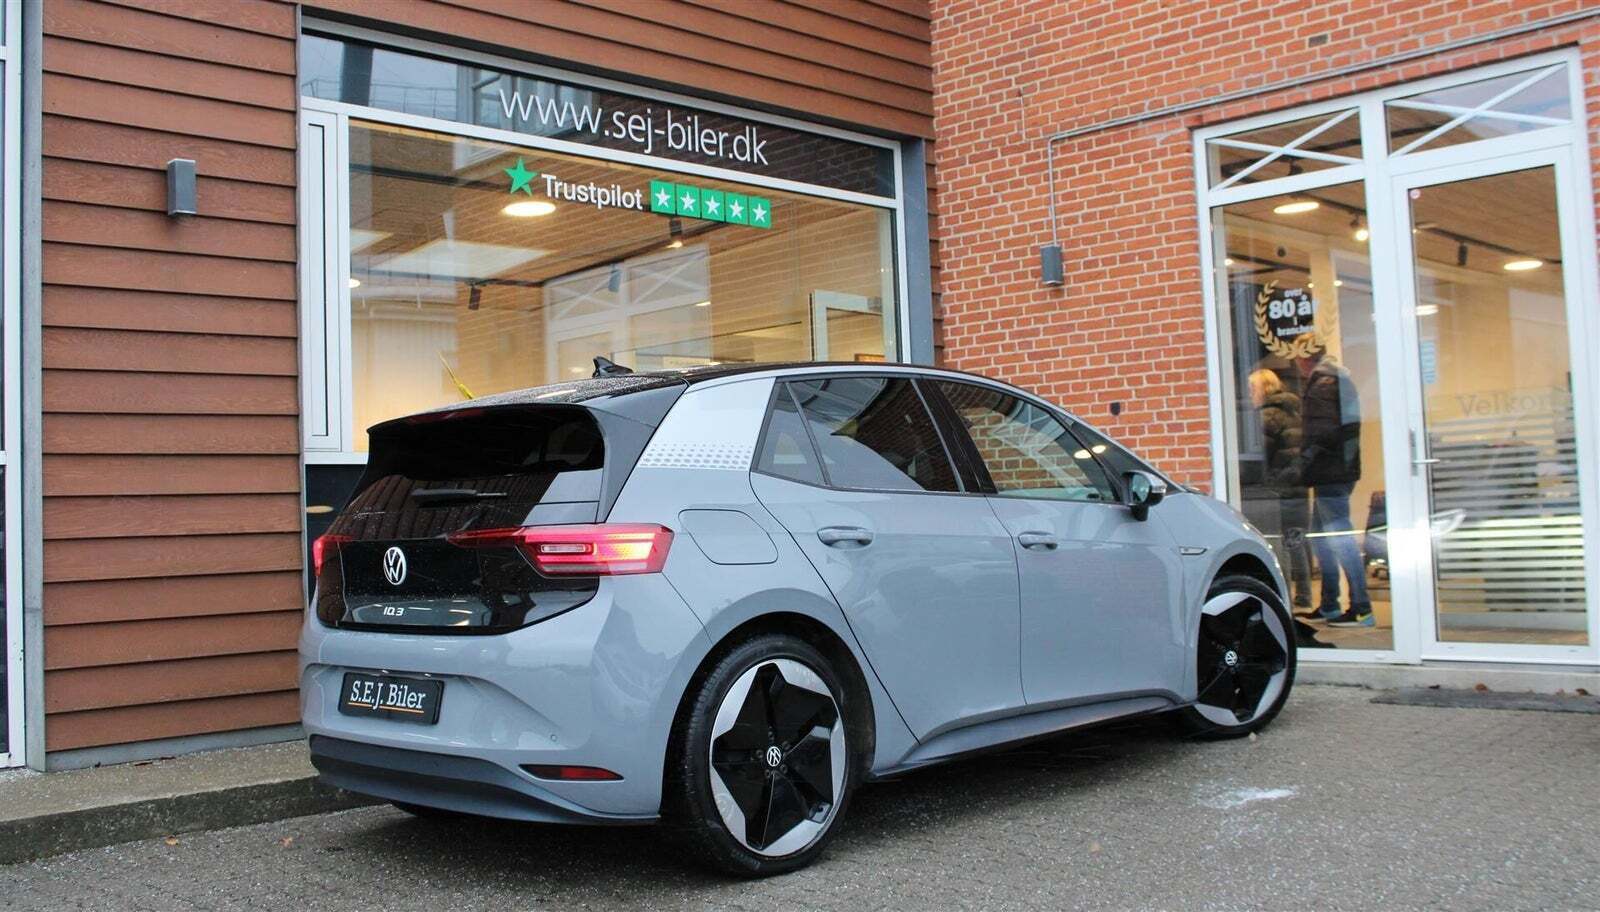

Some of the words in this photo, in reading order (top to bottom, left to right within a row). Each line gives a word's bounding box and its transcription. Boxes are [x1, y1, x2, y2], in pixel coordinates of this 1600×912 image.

[499, 88, 769, 166] www.sej-biler.dk
[541, 173, 644, 211] Trustpilot
[1268, 298, 1296, 319] 80
[350, 680, 384, 710] S.E.J.
[387, 684, 427, 709] Biler
